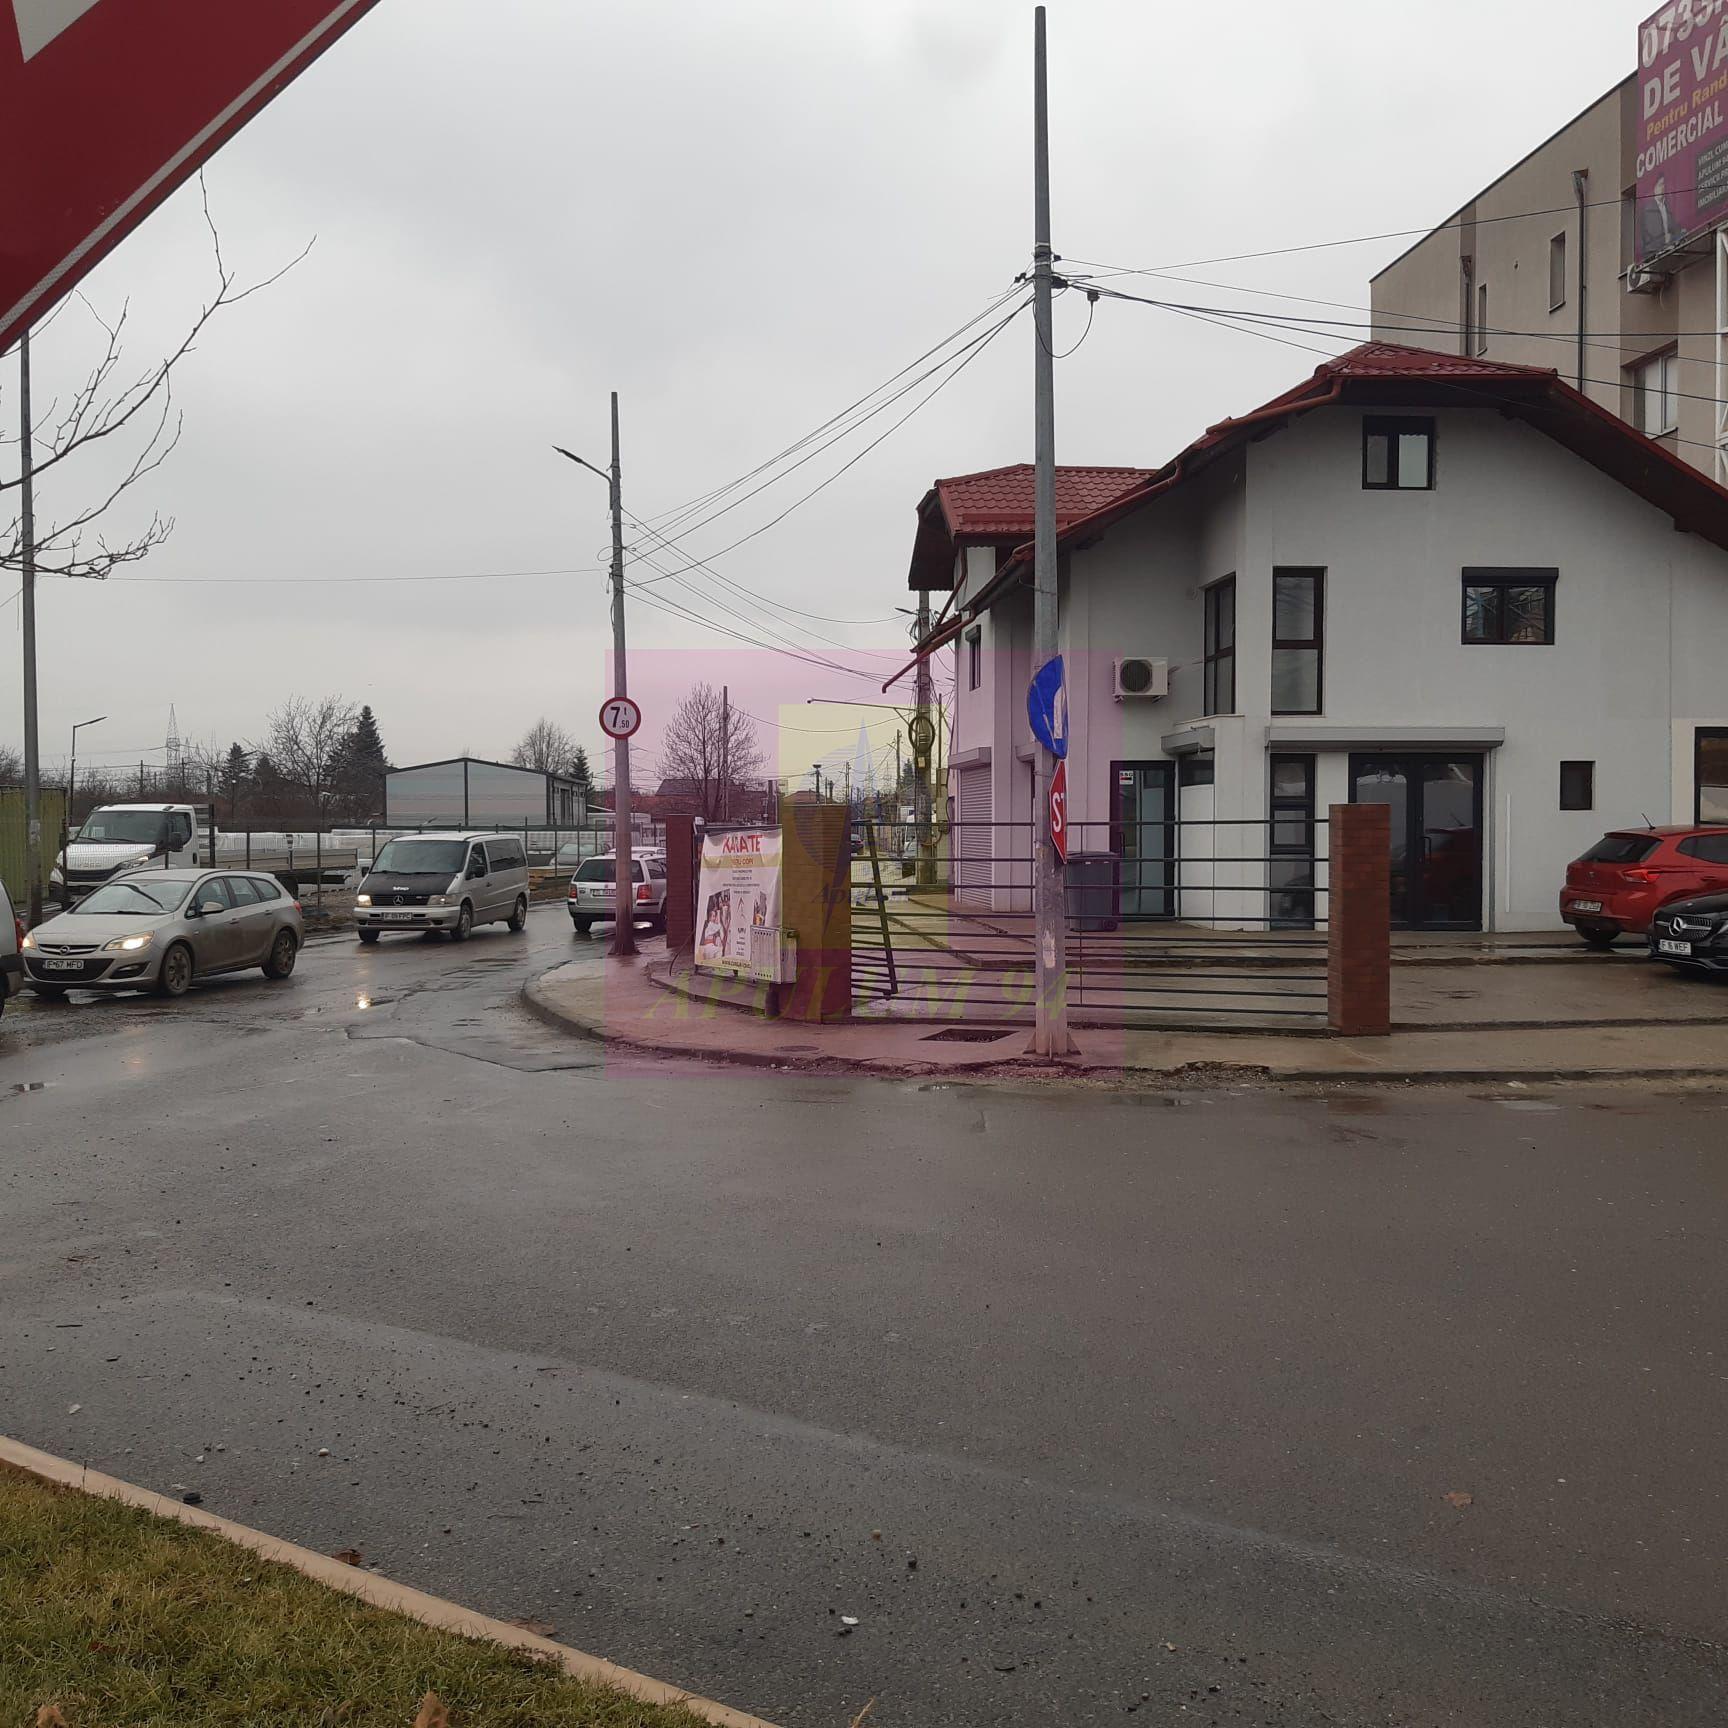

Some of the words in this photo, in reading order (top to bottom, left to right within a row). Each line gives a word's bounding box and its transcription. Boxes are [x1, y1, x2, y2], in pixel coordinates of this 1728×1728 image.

[1644, 60, 1681, 120] DE
[1637, 100, 1723, 178] COMERCIAL
[1647, 101, 1688, 141] Pentru
[610, 706, 621, 728] 7
